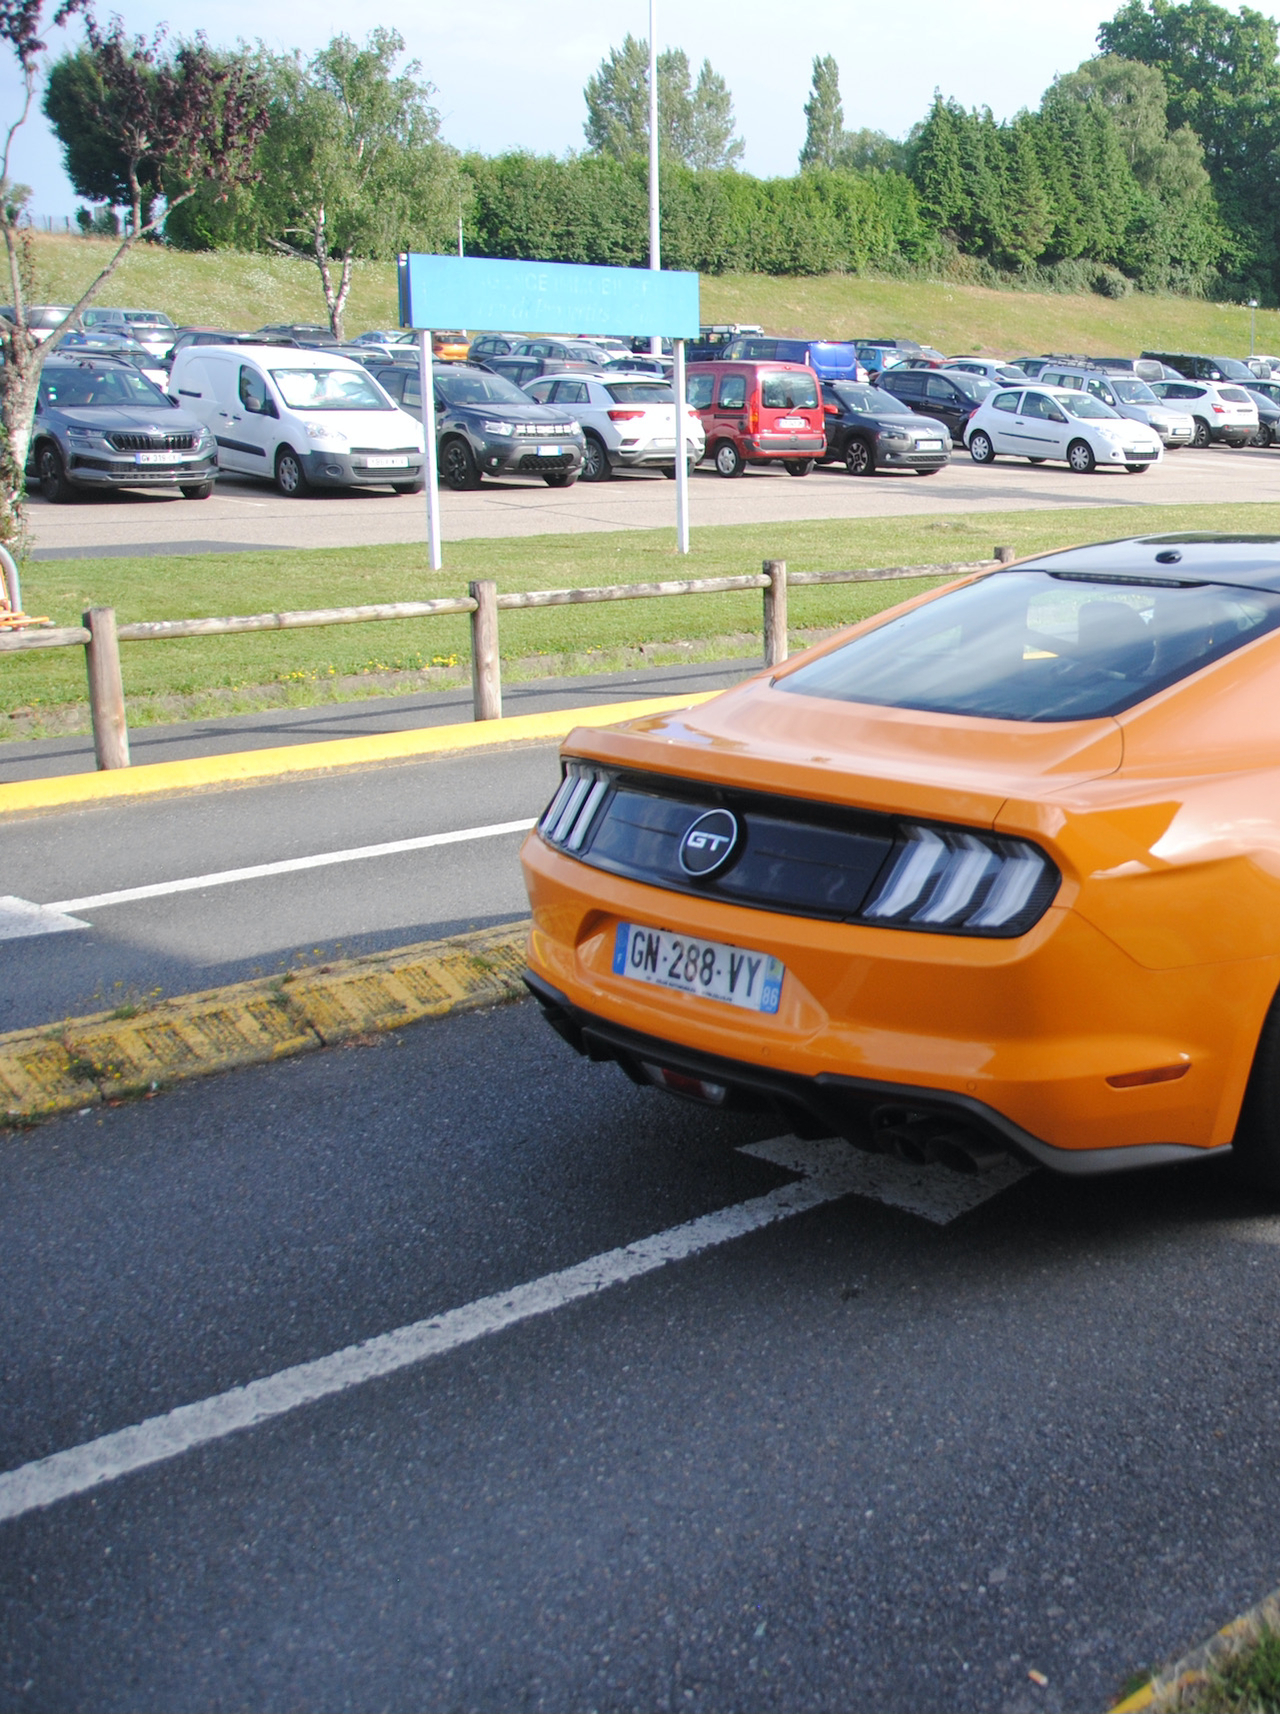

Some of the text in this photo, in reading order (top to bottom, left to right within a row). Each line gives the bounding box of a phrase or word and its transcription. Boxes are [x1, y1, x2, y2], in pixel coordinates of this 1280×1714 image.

[687, 831, 730, 851] GT
[631, 930, 762, 997] GN-288-VY
[762, 986, 779, 1007] 86
